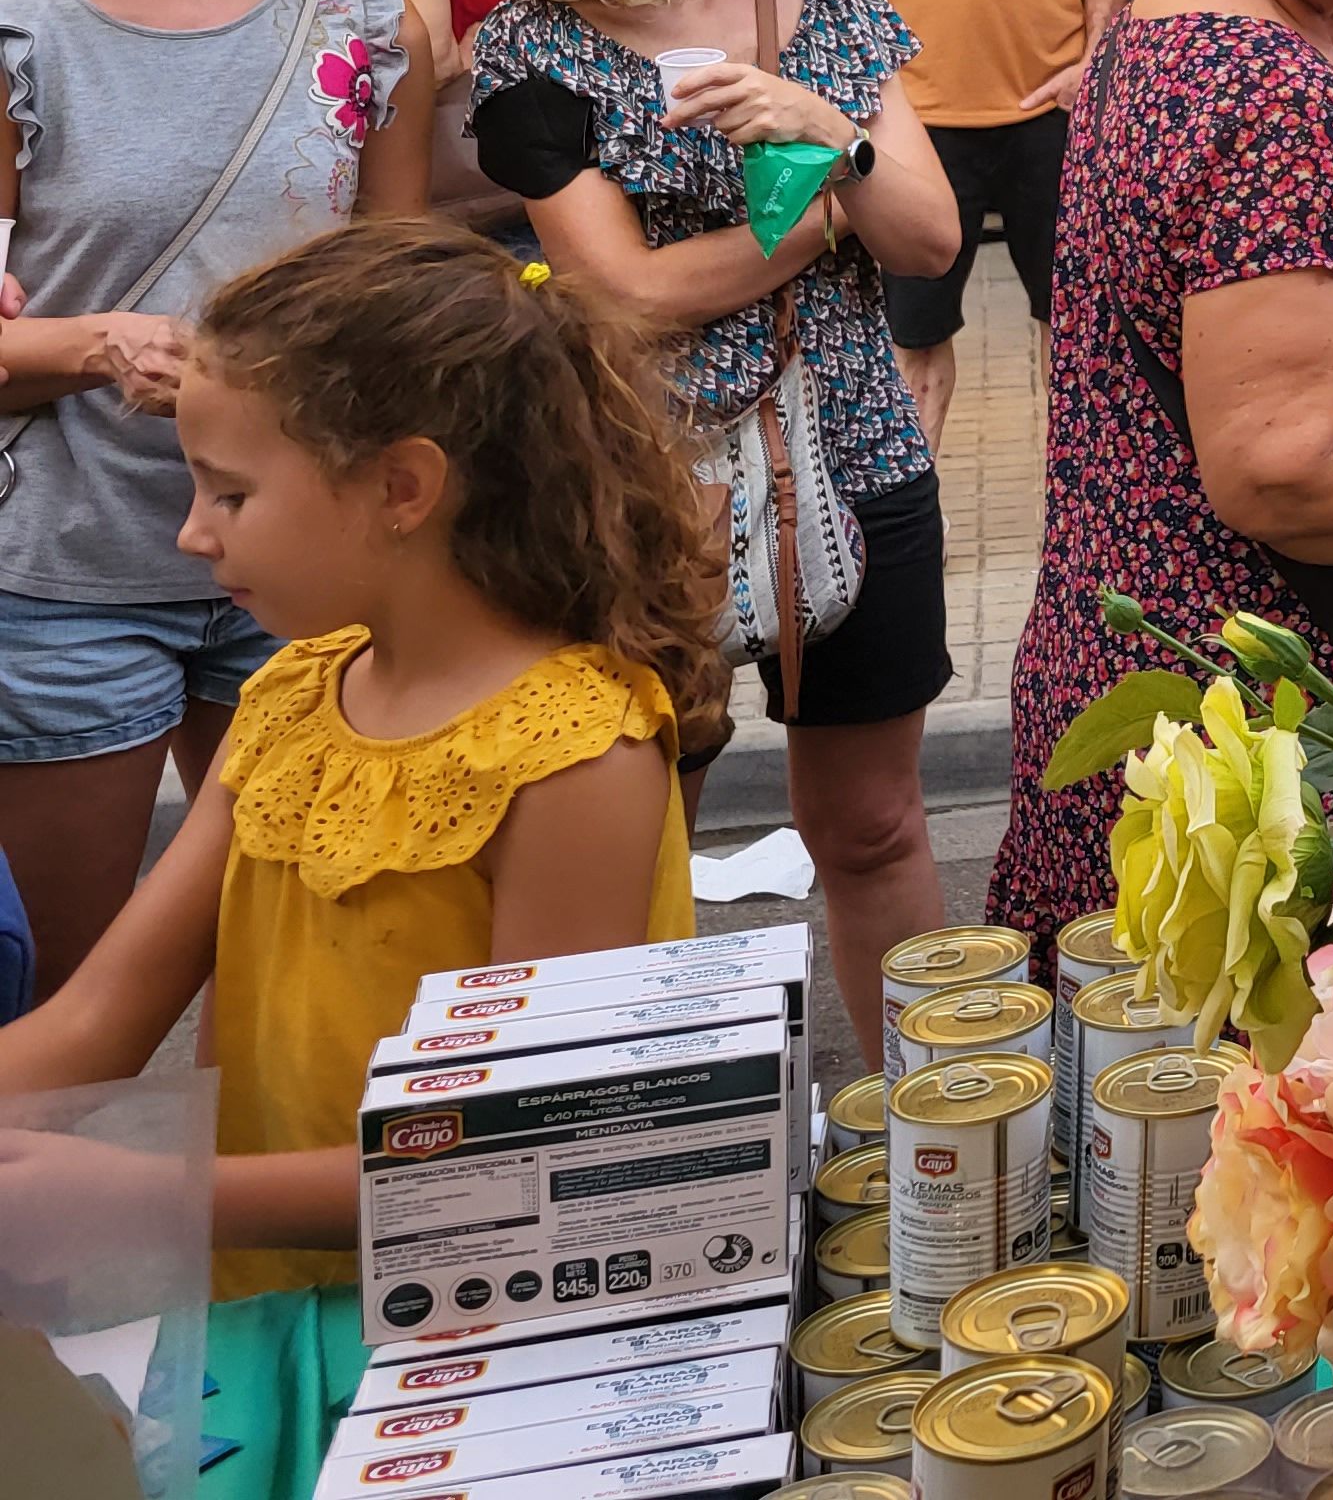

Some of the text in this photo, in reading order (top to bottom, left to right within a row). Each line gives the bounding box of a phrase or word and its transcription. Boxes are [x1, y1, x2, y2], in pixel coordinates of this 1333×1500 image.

[463, 969, 528, 987] Cayo
[453, 1000, 519, 1017] Cayo
[411, 1073, 481, 1091] Cayo
[517, 1071, 711, 1108] ESPÁRRAGOS BLANCOS
[391, 1126, 454, 1150] Cayo
[575, 1119, 655, 1139] MENDAVIA
[918, 1155, 953, 1172] Cayo
[909, 1179, 965, 1193] YEMAS
[1159, 1252, 1177, 1267] 300
[608, 1270, 649, 1290] 220g
[663, 1263, 692, 1280] 370
[556, 1278, 597, 1298] 345g
[406, 1368, 477, 1386] Cayo
[383, 1416, 456, 1435] Cayo
[368, 1459, 443, 1479] Cayo
